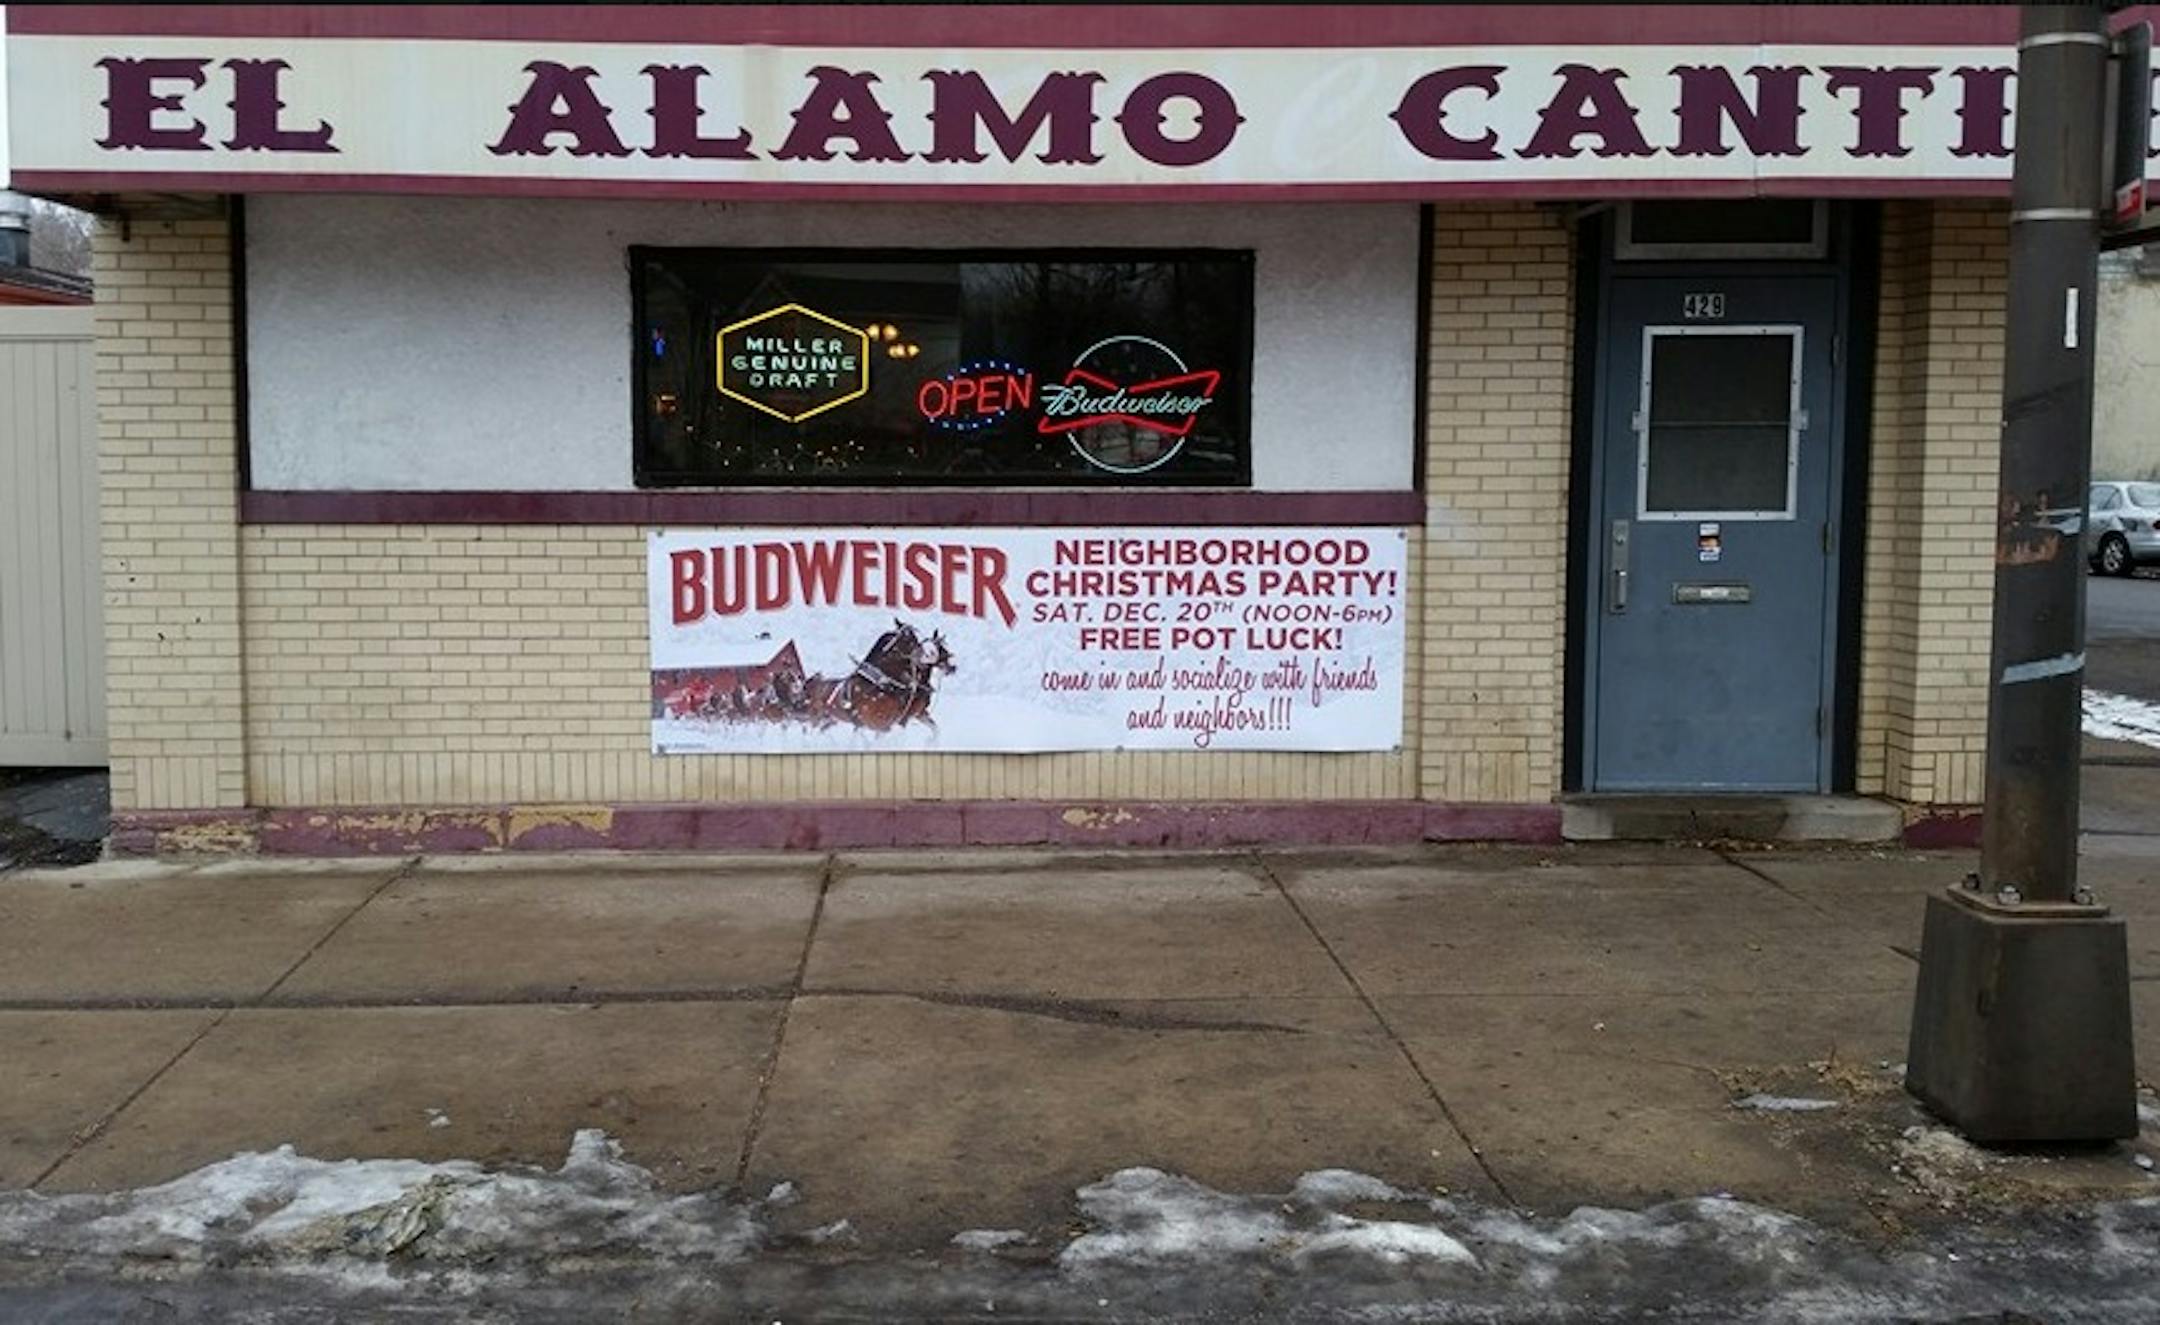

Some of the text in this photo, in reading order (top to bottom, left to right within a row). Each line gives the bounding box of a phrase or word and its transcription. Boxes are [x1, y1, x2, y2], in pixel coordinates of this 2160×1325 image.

[94, 57, 2160, 167] EL ALAMO CANTI
[1685, 295, 1722, 315] 429
[747, 337, 842, 354] MILLER
[731, 355, 857, 371] GENUINE
[749, 373, 838, 388] DRAFT
[919, 372, 1031, 418] OPEN
[1041, 384, 1213, 416] Budweiser
[1055, 538, 1370, 566] NEIGHBORHOOD
[670, 541, 1016, 629] BUDWEISER
[1026, 570, 1397, 597] CHRISTMAS PARTY!
[1033, 601, 1392, 625] SAT. DEC. 20TH (NOON-6PM)
[1080, 627, 1342, 650] FREE POT LUCK!
[1042, 656, 1377, 707] come in and socialize with friends
[1127, 697, 1292, 748] and neighbors!!!
